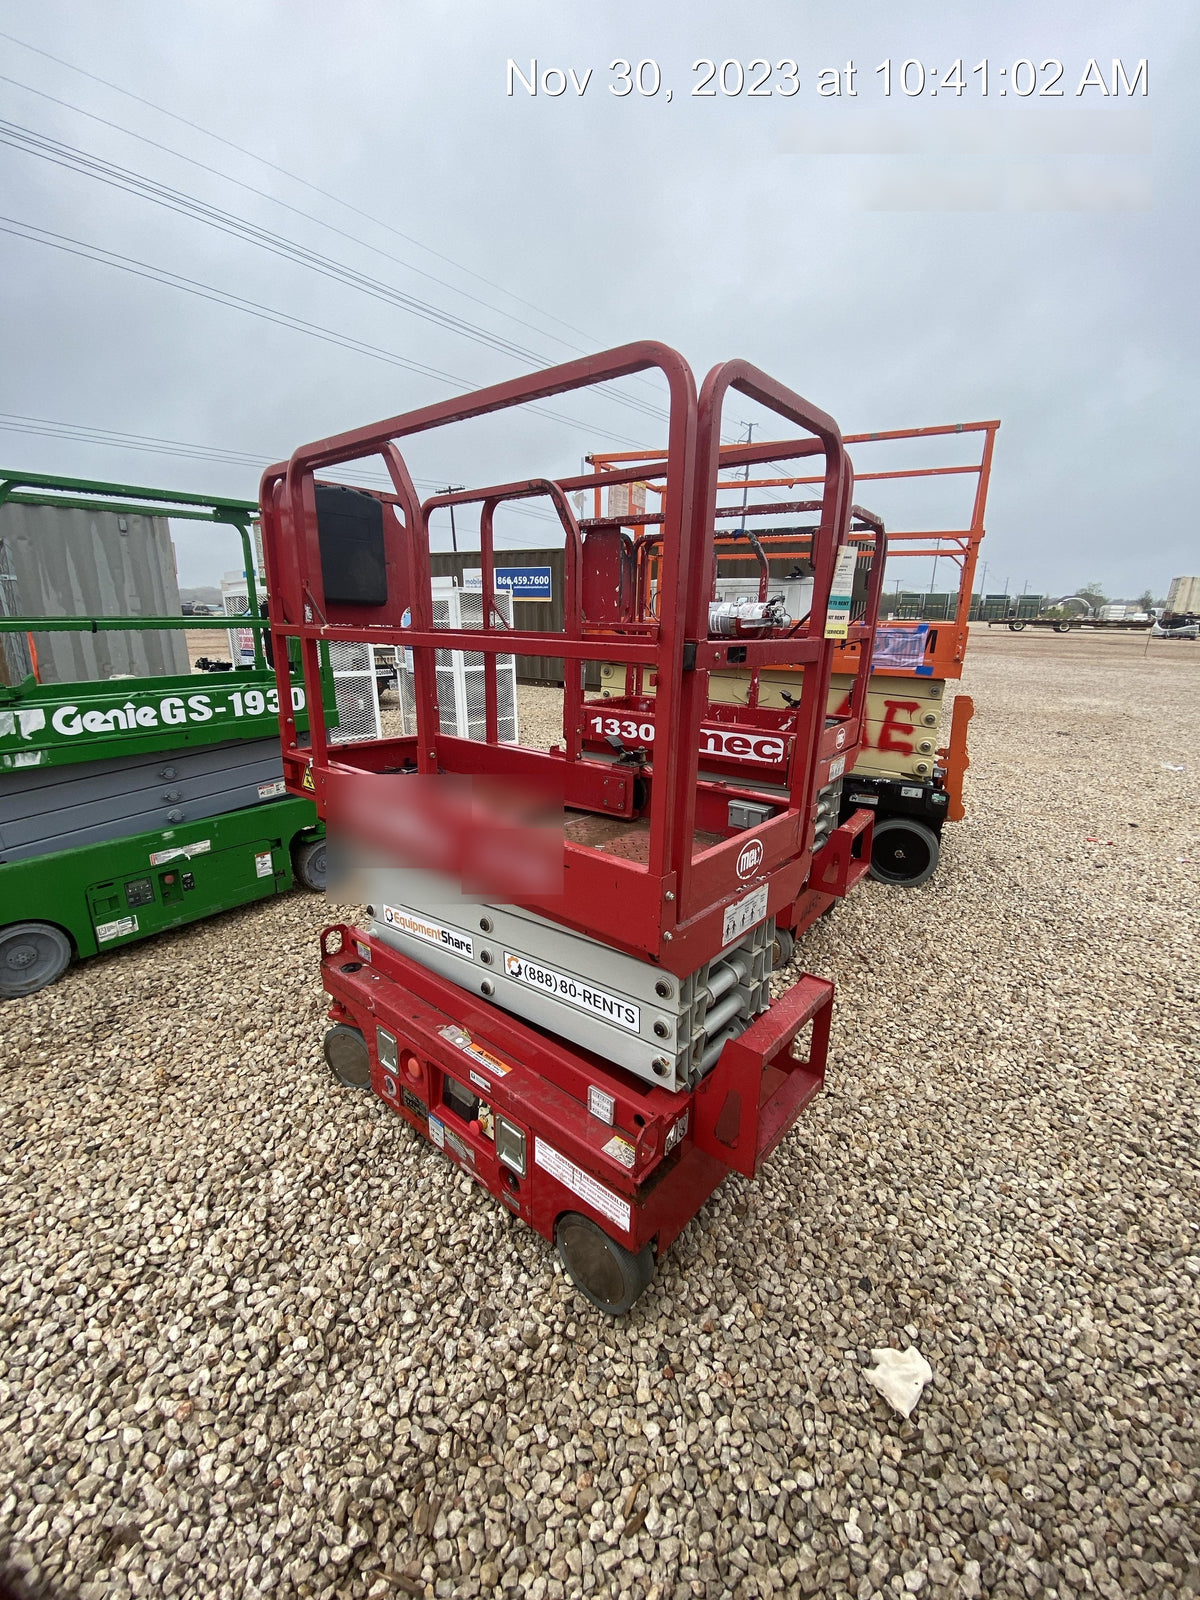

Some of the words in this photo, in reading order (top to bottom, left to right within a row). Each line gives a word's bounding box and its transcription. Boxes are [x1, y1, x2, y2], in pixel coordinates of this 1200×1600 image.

[497, 575, 549, 585] 866.459.7600
[51, 701, 158, 736] Genie
[159, 686, 306, 726] GS-1930
[590, 716, 655, 742] 1330
[393, 907, 472, 954] EquipmentShare
[554, 1153, 583, 1179] CUSTOMER
[582, 1174, 630, 1212] RESPONSIBILITY
